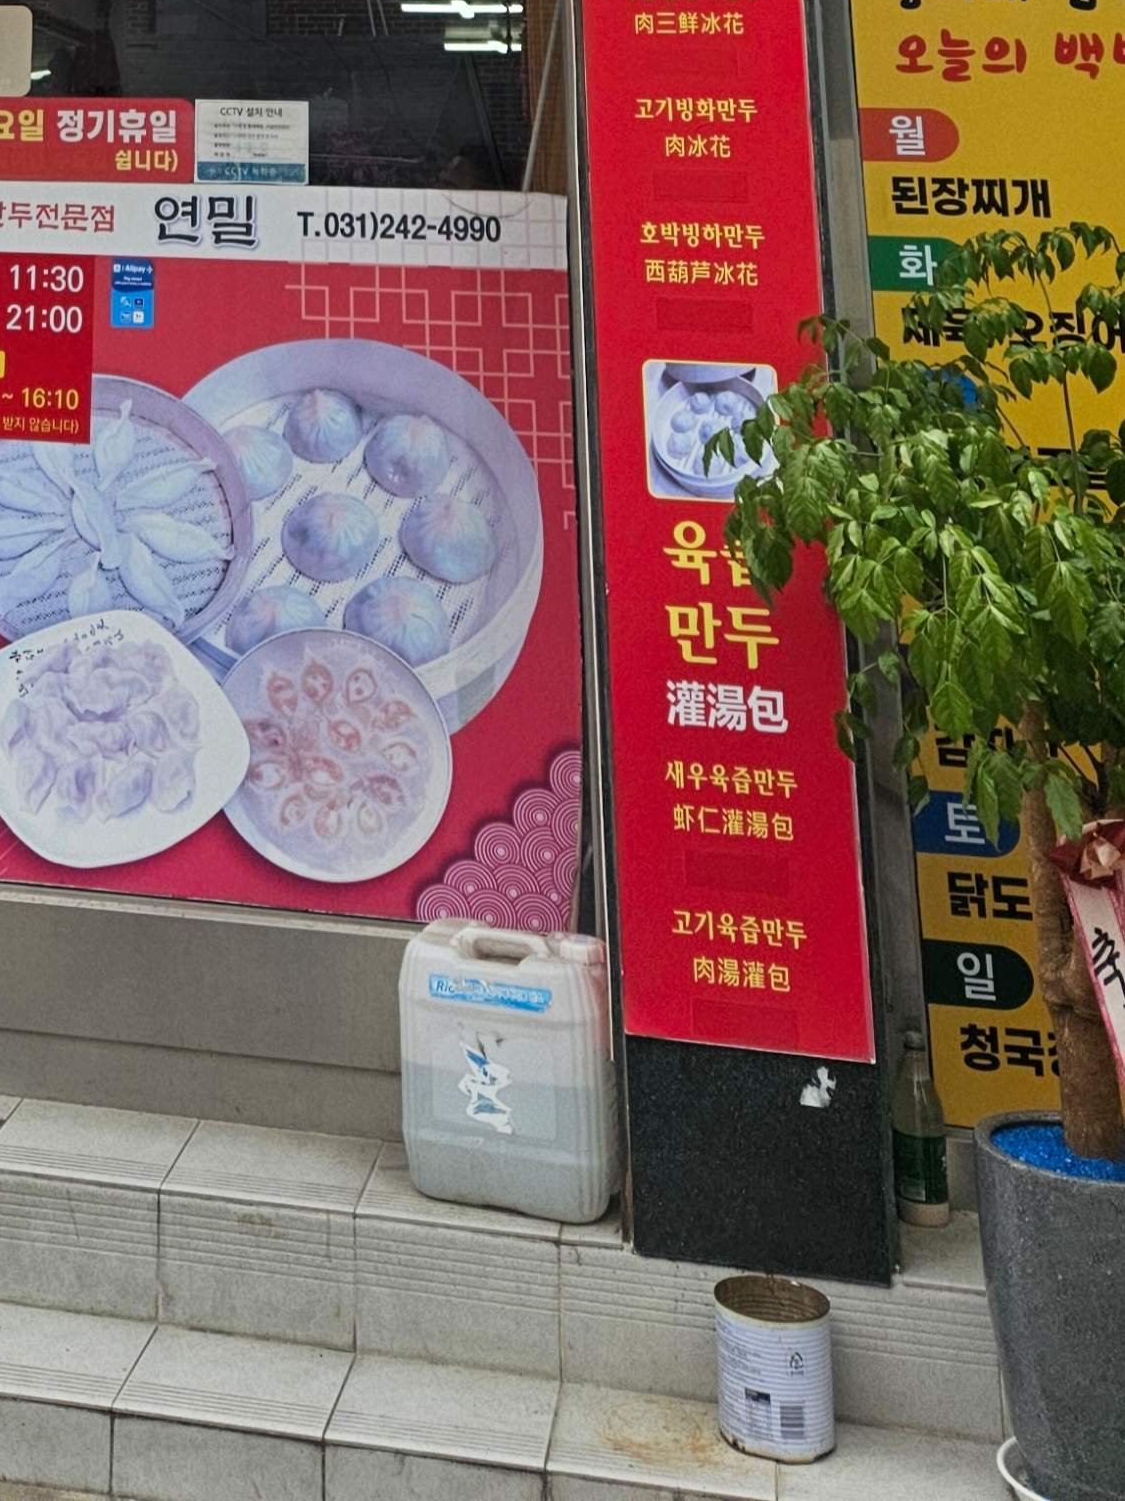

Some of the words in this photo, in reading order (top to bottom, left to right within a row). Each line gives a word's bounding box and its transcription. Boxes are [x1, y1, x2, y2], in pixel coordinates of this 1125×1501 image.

[635, 12, 744, 34] 肉三鲜冰花
[895, 28, 1027, 82] 오늘의
[56, 109, 177, 144] 정기휴일
[220, 107, 243, 117] CCTV
[265, 108, 283, 118] 안내
[634, 97, 758, 122] 고기빙화만두
[665, 134, 731, 158] 肉冰花
[889, 115, 925, 156] 월
[115, 150, 179, 172] 쉽니다)
[891, 176, 1052, 219] 된장찌개
[154, 194, 258, 247] 연밀
[297, 211, 502, 243] T.031)242-4990
[640, 222, 765, 249] 호박빙하만두
[10, 264, 84, 293] 11:30
[645, 259, 758, 286] 西葫芦冰花
[900, 244, 938, 286] 화
[6, 304, 83, 333] 21:00
[22, 388, 79, 410] 16:10
[3, 416, 25, 431] 받지
[29, 417, 79, 434] 않습니다)
[665, 602, 779, 669] 만두
[666, 679, 788, 734] 灌湯包
[665, 759, 798, 798] 새우육즙만두
[674, 803, 794, 841] 虾仁灌湯包
[671, 910, 807, 950] 고기육즙만두
[693, 956, 791, 992] 肉湯灌包
[956, 952, 997, 1001] 일
[960, 1024, 1061, 1077] 청국
